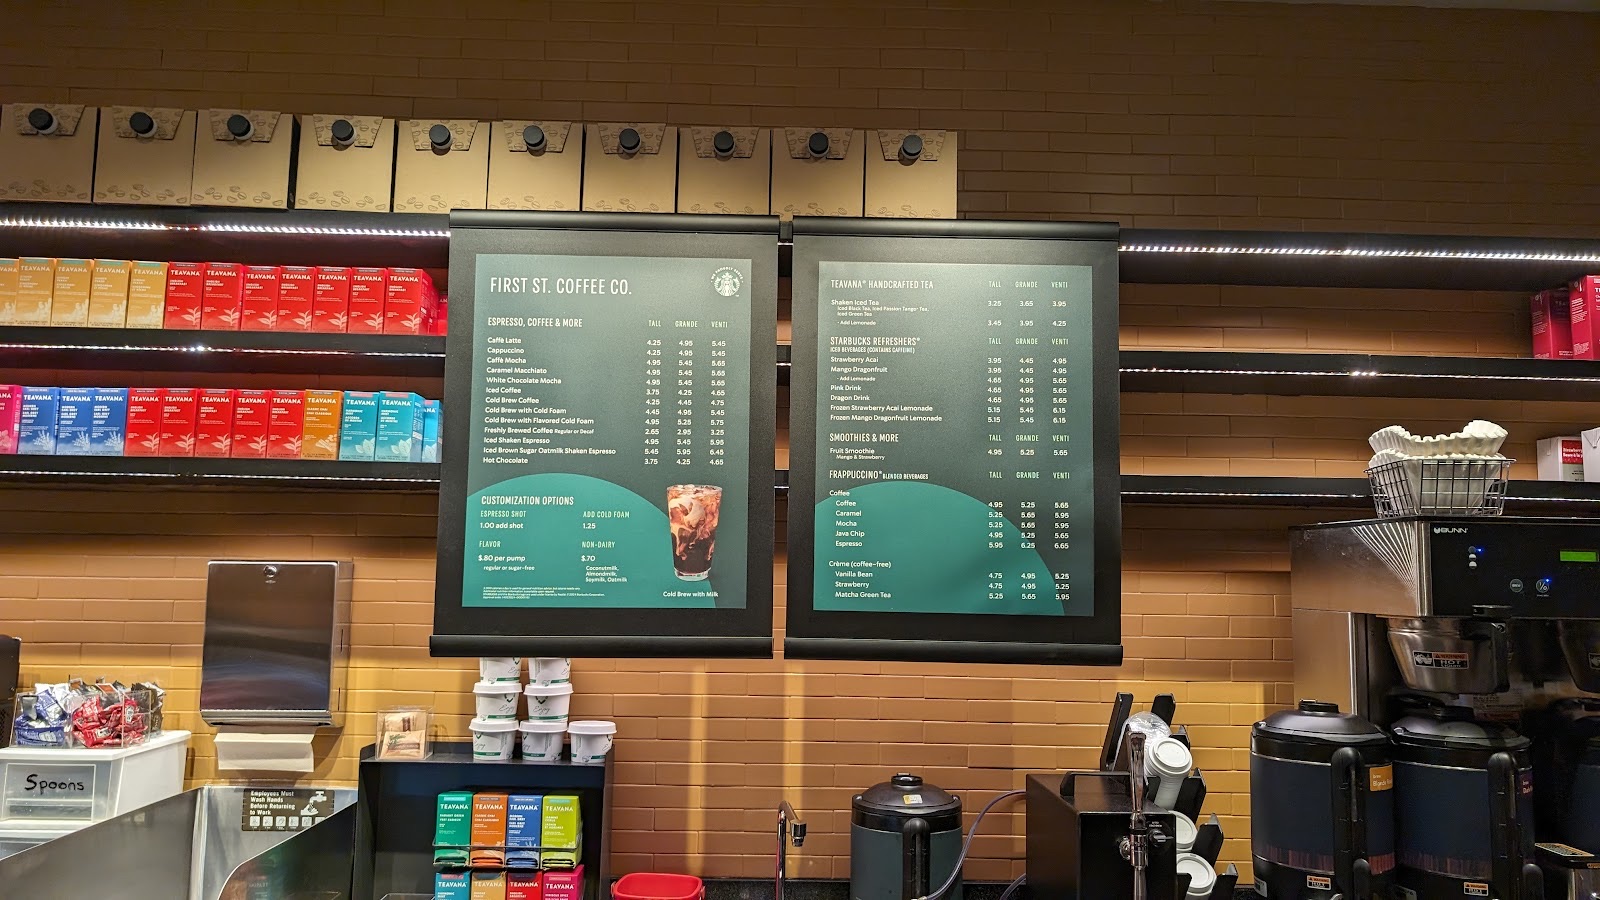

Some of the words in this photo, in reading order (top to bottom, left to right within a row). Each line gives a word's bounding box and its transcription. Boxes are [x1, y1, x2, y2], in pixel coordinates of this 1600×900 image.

[490, 277, 528, 293] FIRST
[532, 277, 551, 294] ST.
[556, 278, 606, 294] COFFEE
[610, 279, 632, 295] CO.
[831, 279, 863, 289] TEAVANA
[869, 280, 919, 289] HANDCRAFTED
[921, 280, 934, 289] TEA
[488, 317, 526, 327] ESPRESSO,
[527, 317, 553, 327] COFFEE
[555, 318, 561, 327] &
[563, 318, 583, 327] MORE
[830, 336, 871, 346] STARBUCKS
[873, 337, 917, 346] REFRESHERS
[989, 337, 1002, 345] TALL
[1015, 337, 1038, 345] GRANDE
[487, 347, 525, 355] Cappuccino
[831, 356, 865, 364] Strawberry
[831, 366, 853, 374] Mango
[853, 366, 888, 374] Dragonfruit
[500, 386, 522, 394] Coffee
[851, 404, 886, 412] Strawberry
[677, 418, 692, 426] 5.25
[484, 426, 507, 435] Freshly
[677, 428, 692, 436] 2.95
[829, 433, 870, 442] SMOOTHIES
[871, 433, 878, 443] &
[879, 433, 899, 443] MORE
[519, 447, 537, 455] Sugar
[829, 470, 879, 479] FRAPPUCCINO
[481, 495, 540, 505] CUSTOMIZATION
[542, 496, 574, 506] OPTIONS
[481, 510, 510, 518] ESPRESSO
[511, 510, 527, 518] SHOT
[850, 530, 865, 538] Chip
[479, 540, 501, 548] FLAVOR
[478, 554, 494, 562] $.80
[1021, 572, 1036, 580] 4.95
[533, 705, 550, 715] Enjoy
[25, 773, 85, 795] Spoons
